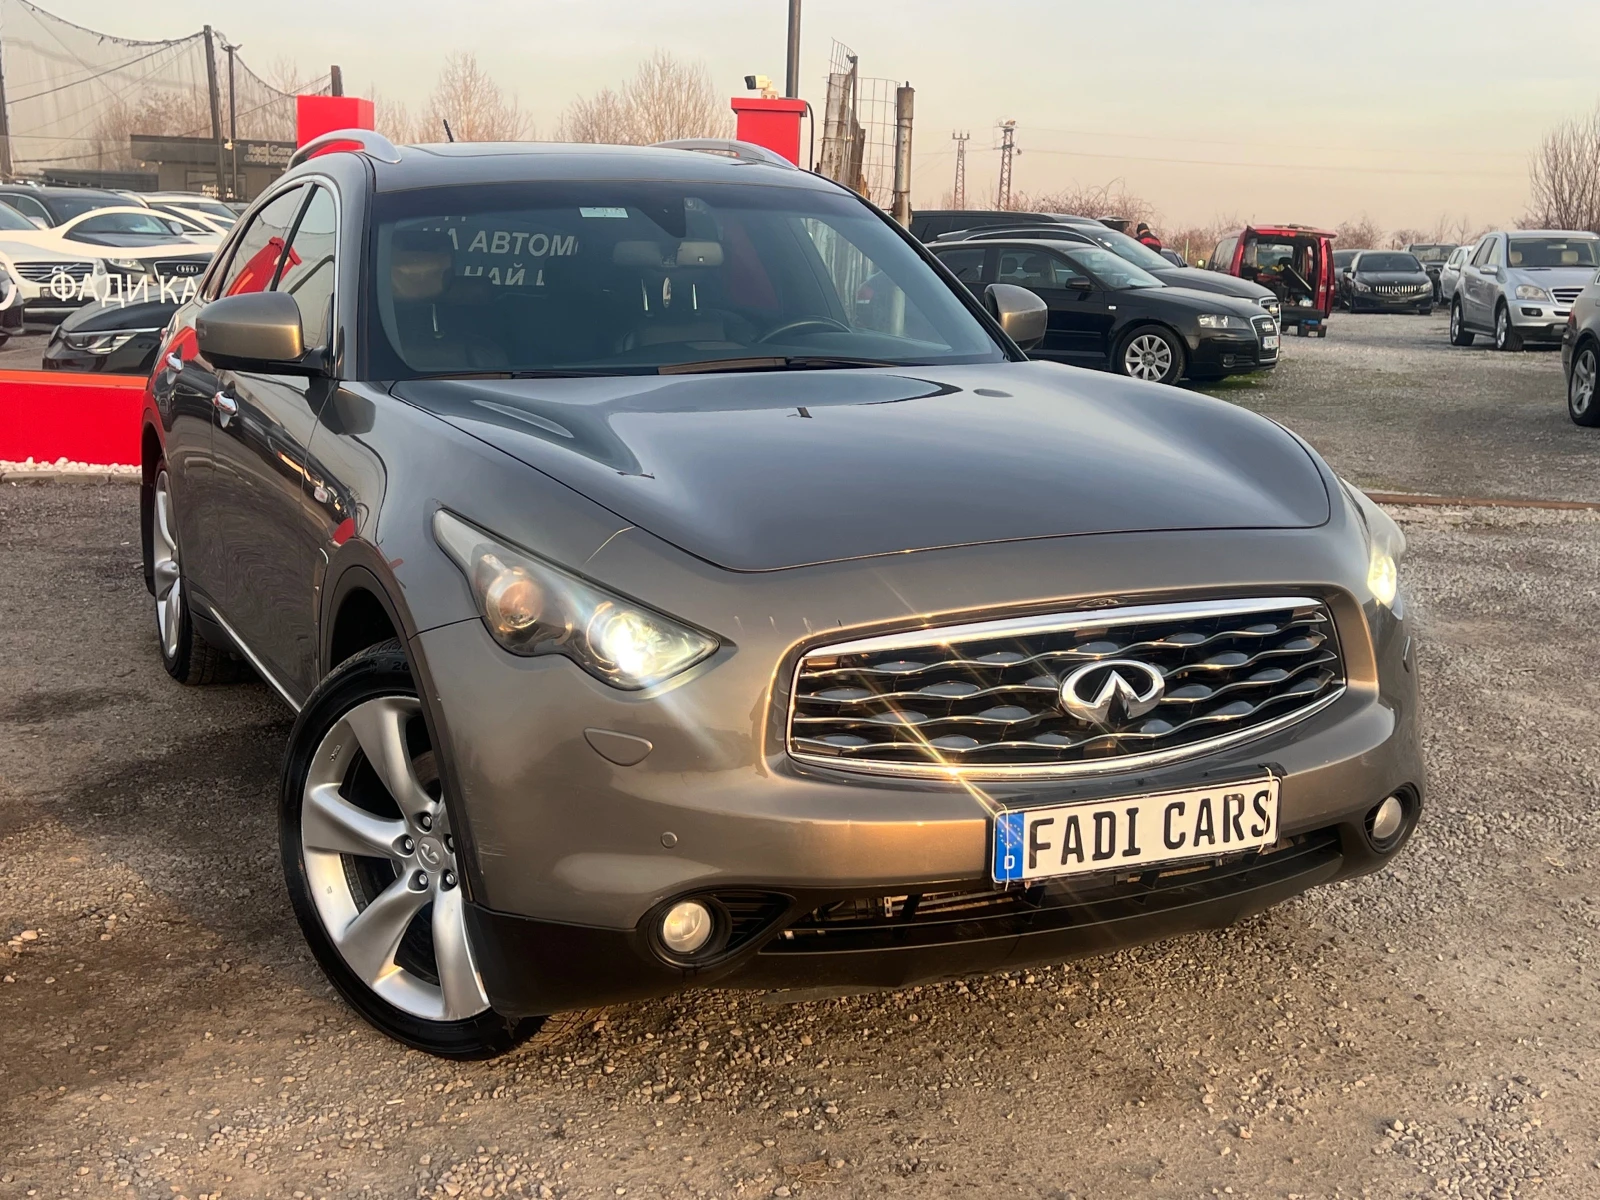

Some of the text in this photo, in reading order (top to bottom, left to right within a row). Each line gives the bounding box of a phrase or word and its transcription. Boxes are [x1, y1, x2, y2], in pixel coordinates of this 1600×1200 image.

[468, 230, 579, 257] АВТОМ
[51, 271, 149, 308] ФАДИ
[1029, 790, 1272, 869] FADI CARS
